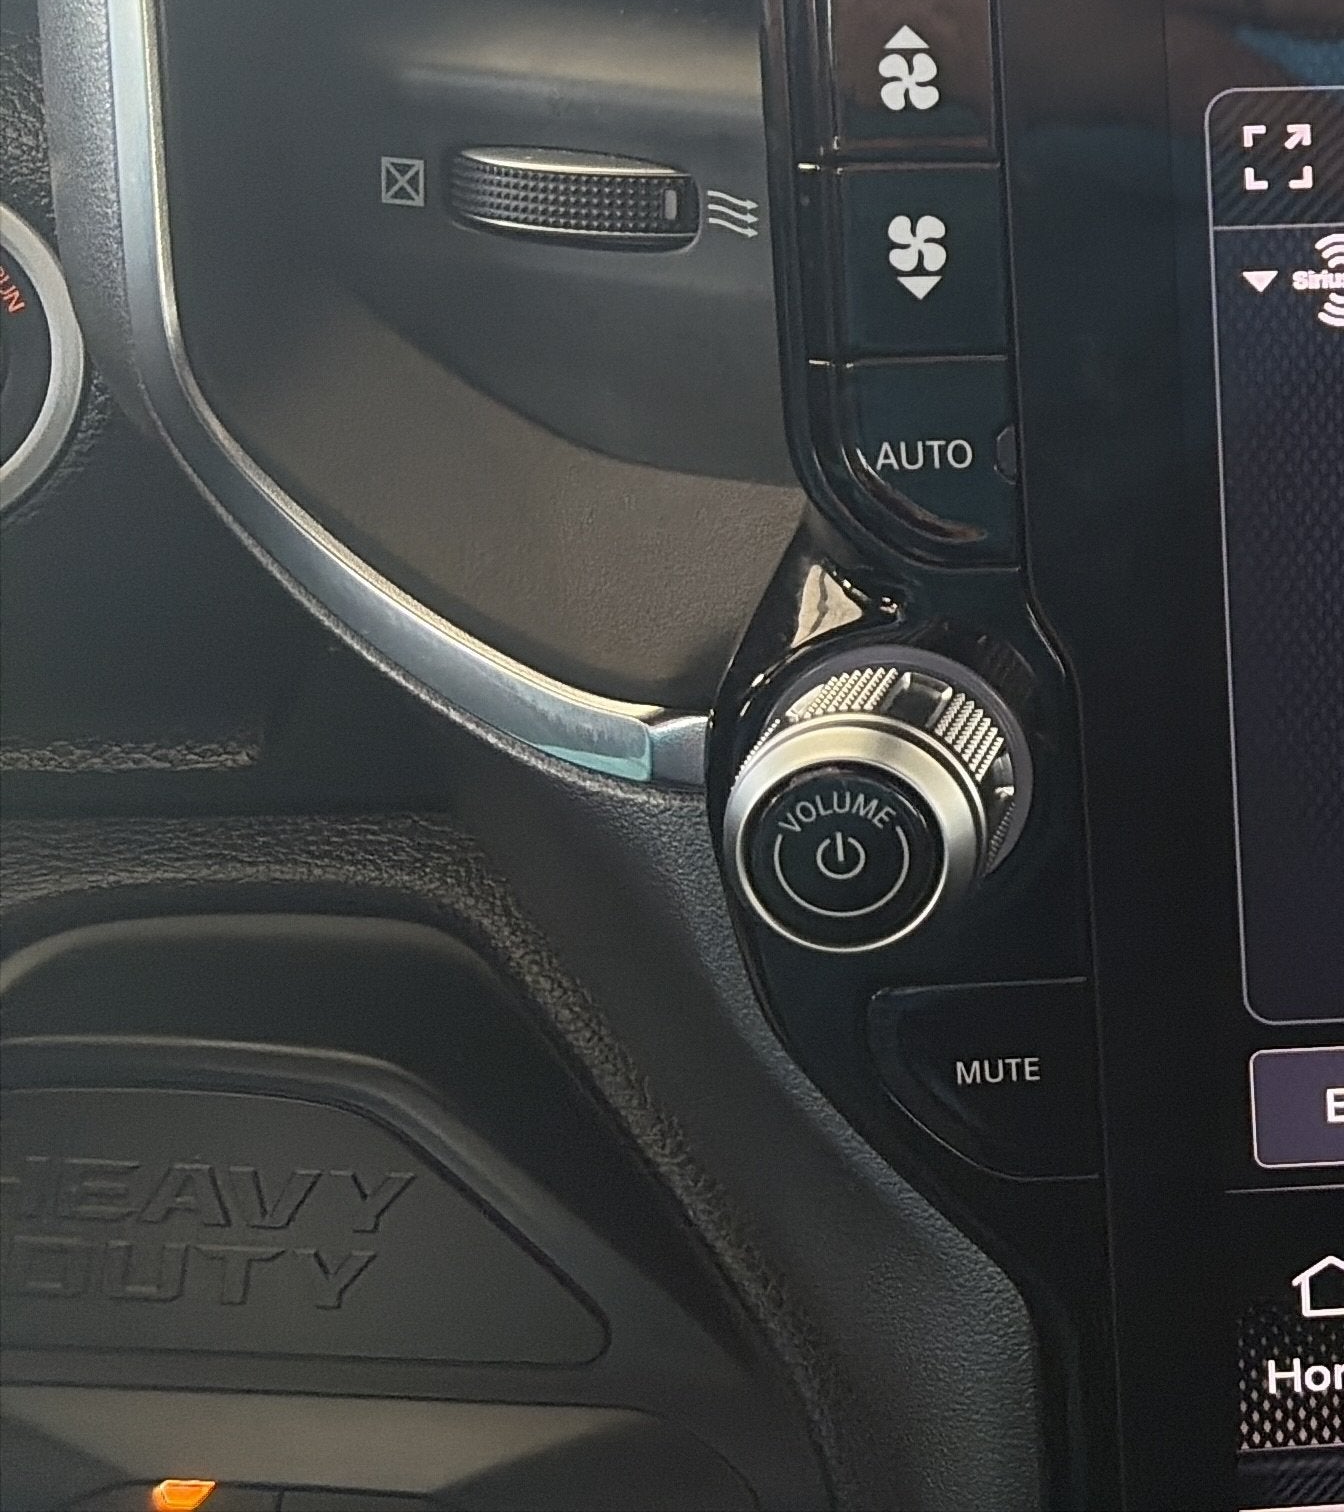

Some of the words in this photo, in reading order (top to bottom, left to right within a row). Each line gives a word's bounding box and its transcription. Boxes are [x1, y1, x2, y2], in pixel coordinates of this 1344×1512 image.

[874, 437, 974, 472] AUTO
[778, 790, 897, 834] VOLUME
[955, 1057, 1041, 1085] MUTE
[4, 1235, 379, 1311] DUTY
